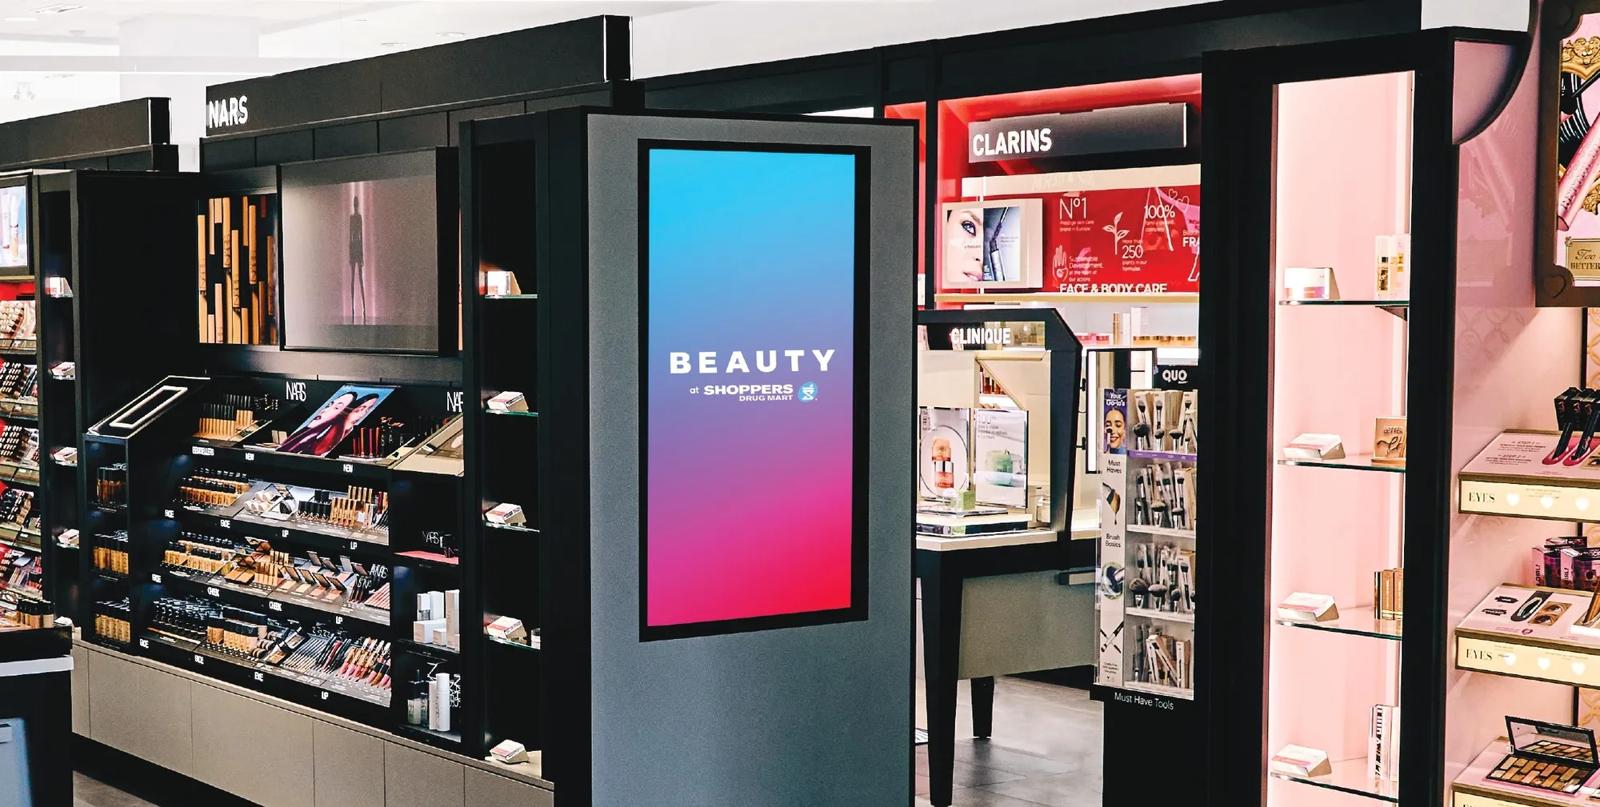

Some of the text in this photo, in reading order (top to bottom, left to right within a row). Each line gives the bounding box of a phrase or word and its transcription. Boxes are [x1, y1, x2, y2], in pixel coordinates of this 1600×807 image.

[208, 95, 249, 129] NARS
[972, 128, 1052, 156] CLARINS
[1144, 204, 1176, 219] 100%
[1122, 244, 1144, 259] 250
[1575, 248, 1597, 260] Too
[1059, 283, 1087, 293] FACE
[1101, 283, 1134, 293] BODY
[1136, 283, 1167, 293] CARE
[951, 328, 1011, 345] CLINIQUE
[669, 349, 835, 374] BEAUTY
[1162, 369, 1188, 384] QUO
[286, 381, 306, 402] NARS
[689, 384, 794, 396] at SHOPPERS
[767, 394, 794, 402] MART
[1468, 491, 1496, 503] EYES
[1466, 648, 1493, 661] EYES
[1114, 692, 1174, 710] Must Have Tools
